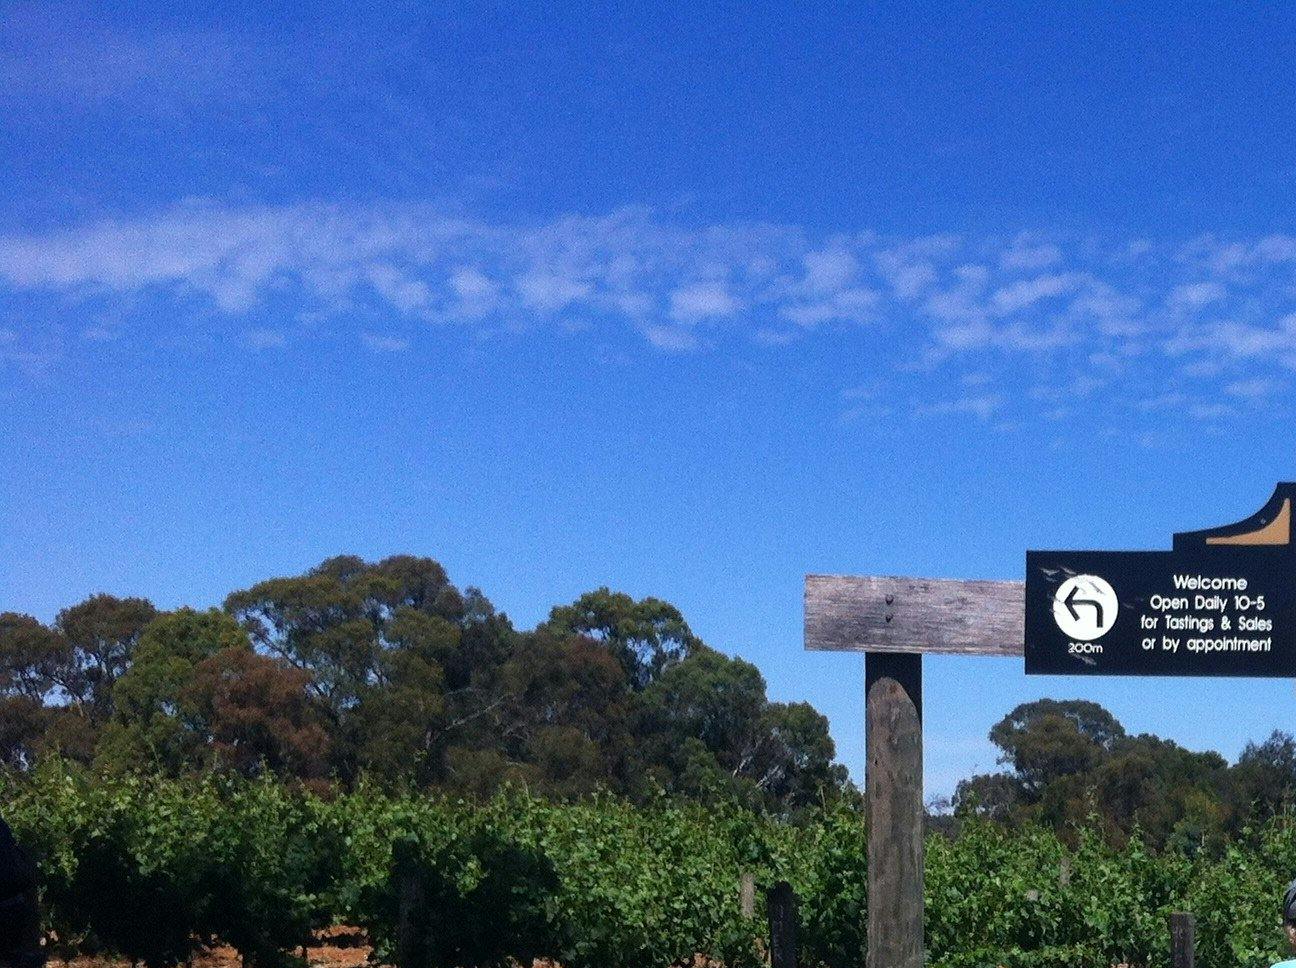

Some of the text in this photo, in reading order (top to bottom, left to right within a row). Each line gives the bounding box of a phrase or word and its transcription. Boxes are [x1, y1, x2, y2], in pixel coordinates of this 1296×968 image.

[1173, 575, 1247, 590] Welcome
[1150, 594, 1188, 612] Open
[1195, 595, 1227, 612] Daily
[1141, 615, 1272, 633] for Tastings & Sales
[1068, 643, 1103, 653] 200m
[1142, 636, 1272, 653] or by appointment
